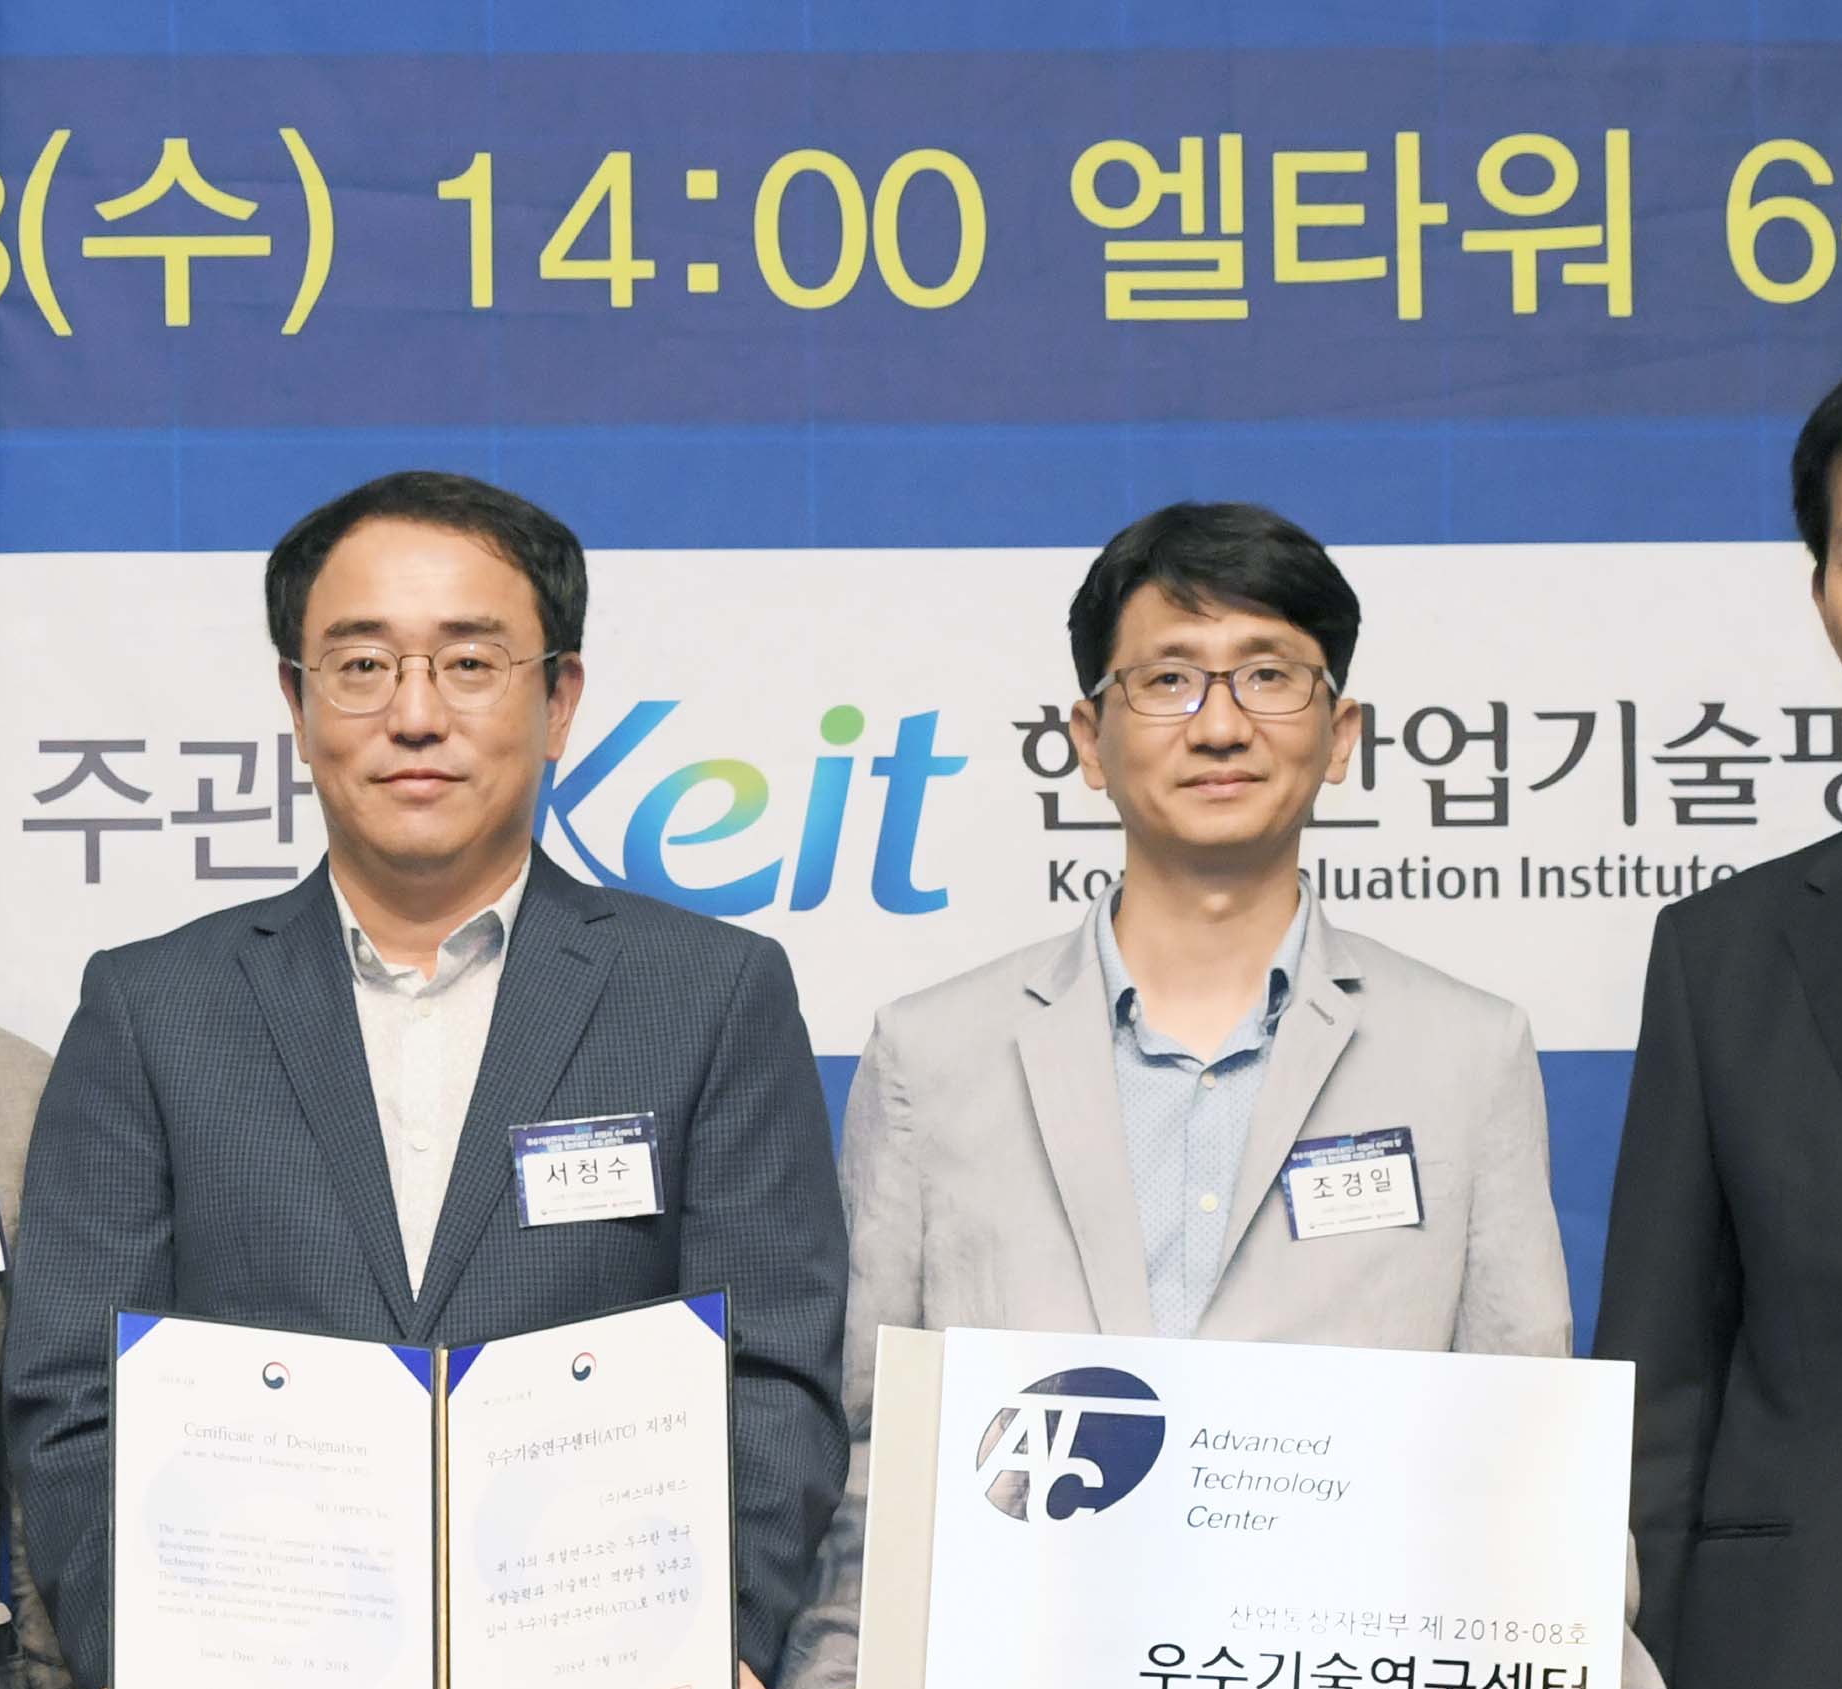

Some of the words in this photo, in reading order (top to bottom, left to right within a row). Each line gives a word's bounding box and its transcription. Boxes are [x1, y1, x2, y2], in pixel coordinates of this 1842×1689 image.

[436, 147, 988, 311] 14:00
[1069, 128, 1634, 321] 엘타워
[22, 733, 314, 884] 주관
[533, 700, 969, 916] Keit
[1189, 1427, 1333, 1457] Advanced
[1190, 1466, 1352, 1503] Technology
[1185, 1506, 1279, 1532] Center
[1419, 1614, 1444, 1641] 제
